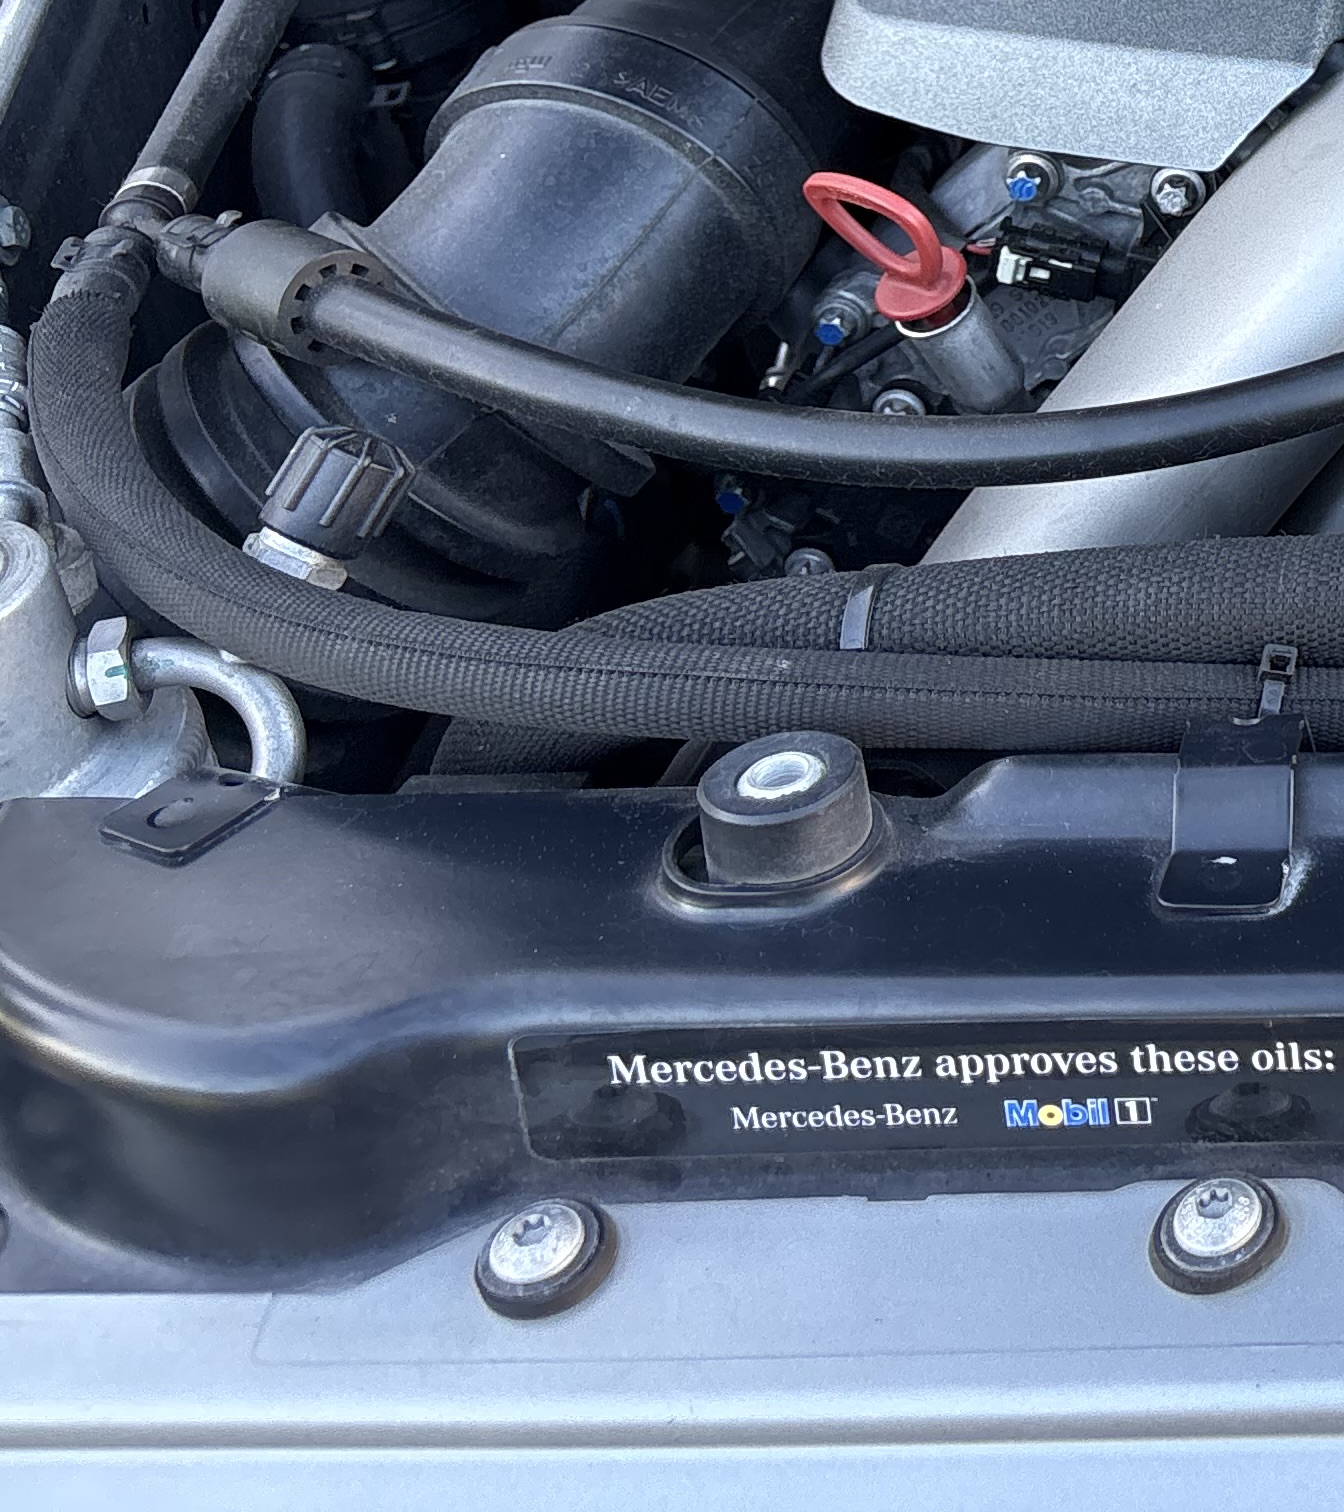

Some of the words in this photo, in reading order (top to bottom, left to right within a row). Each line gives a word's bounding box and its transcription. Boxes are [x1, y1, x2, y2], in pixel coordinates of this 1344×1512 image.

[607, 1050, 922, 1085] Mercedes-Benz
[935, 1046, 1118, 1084] approves
[1129, 1043, 1239, 1074] these
[1251, 1041, 1336, 1073] oils:
[731, 1103, 959, 1131] Mercedes-Benz
[1003, 1098, 1110, 1129] Mobil
